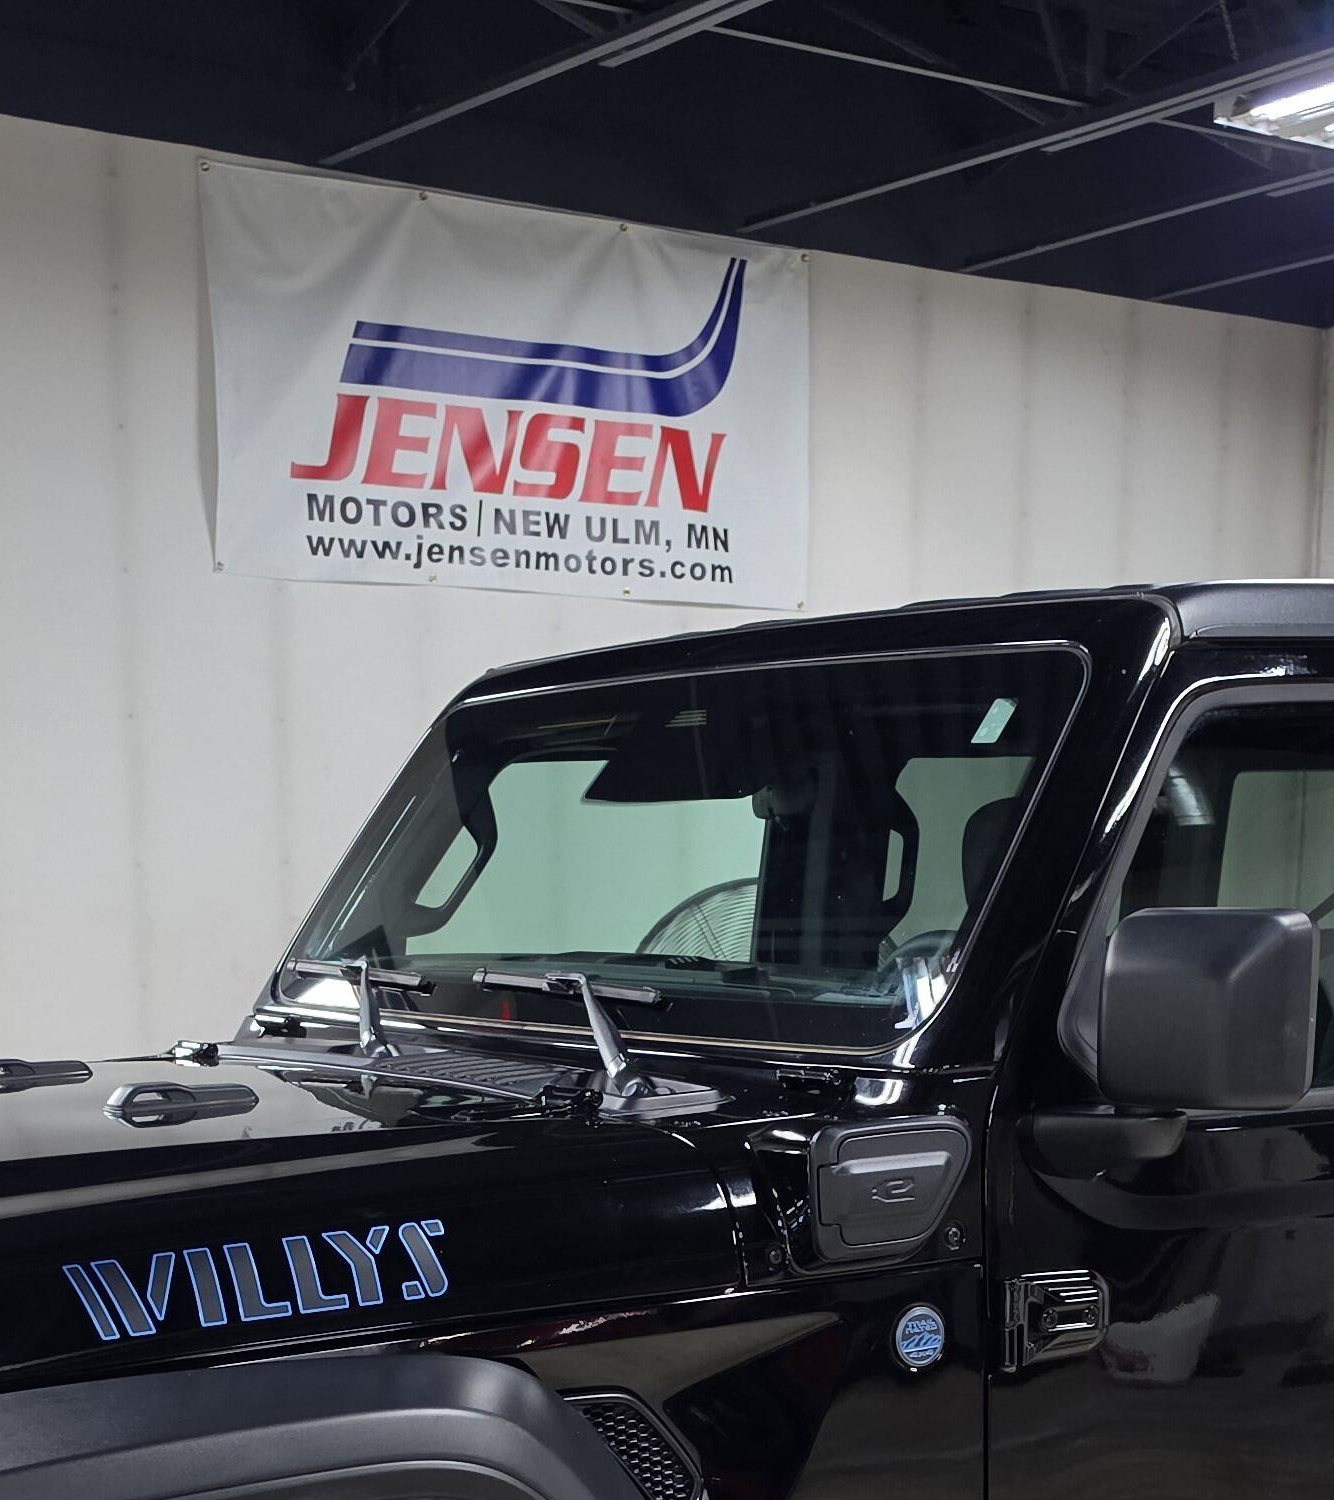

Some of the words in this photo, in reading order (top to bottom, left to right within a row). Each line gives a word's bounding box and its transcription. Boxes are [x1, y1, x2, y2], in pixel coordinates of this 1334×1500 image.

[290, 393, 727, 513] JENSEN
[305, 533, 734, 584] www.jensenmotors.com
[306, 492, 469, 532] MOTORS
[493, 506, 571, 540] NEW
[584, 514, 672, 553] ULM,
[685, 520, 730, 554] MN
[62, 1219, 448, 1341] WILLYS
